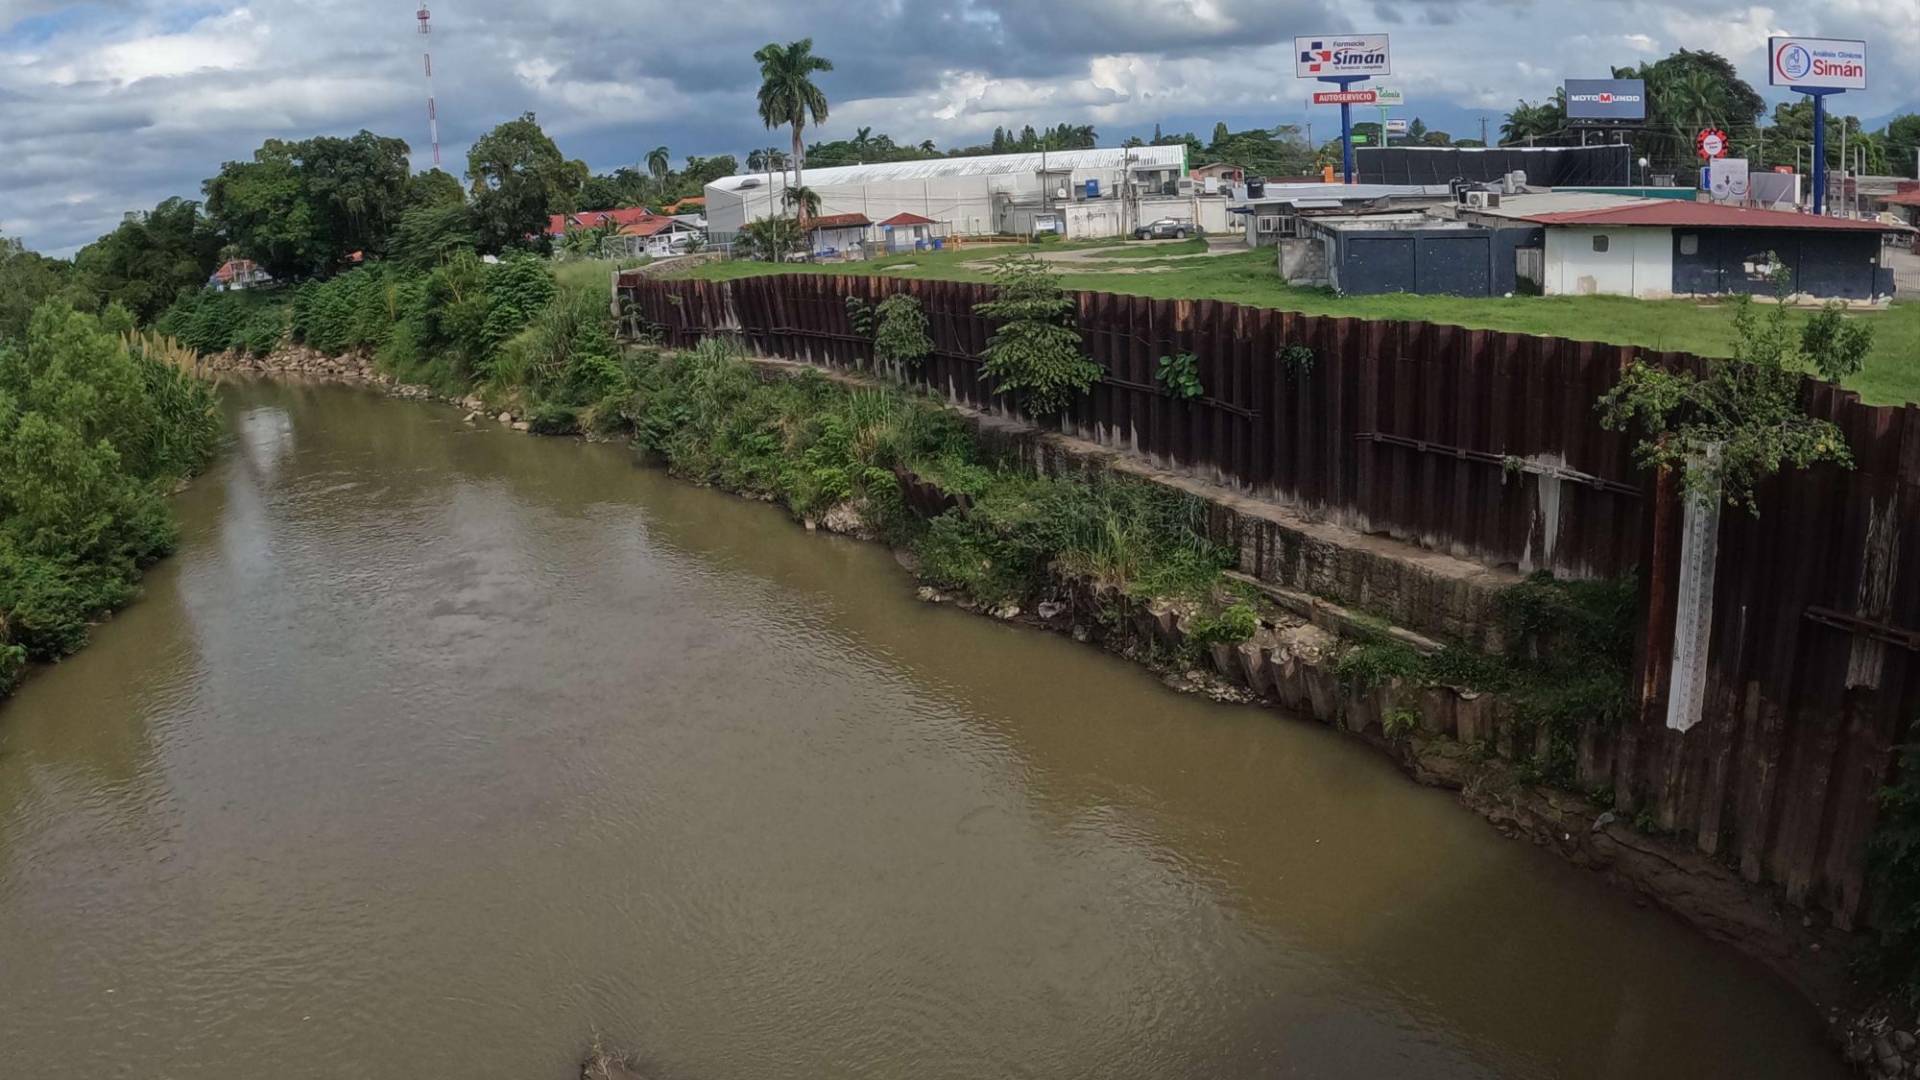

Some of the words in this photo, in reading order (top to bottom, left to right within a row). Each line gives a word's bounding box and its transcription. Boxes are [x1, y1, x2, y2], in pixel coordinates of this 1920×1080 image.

[1333, 49, 1385, 65] Simán
[1813, 59, 1863, 77] Simán
[1319, 92, 1372, 101] AUTOSERVICIO
